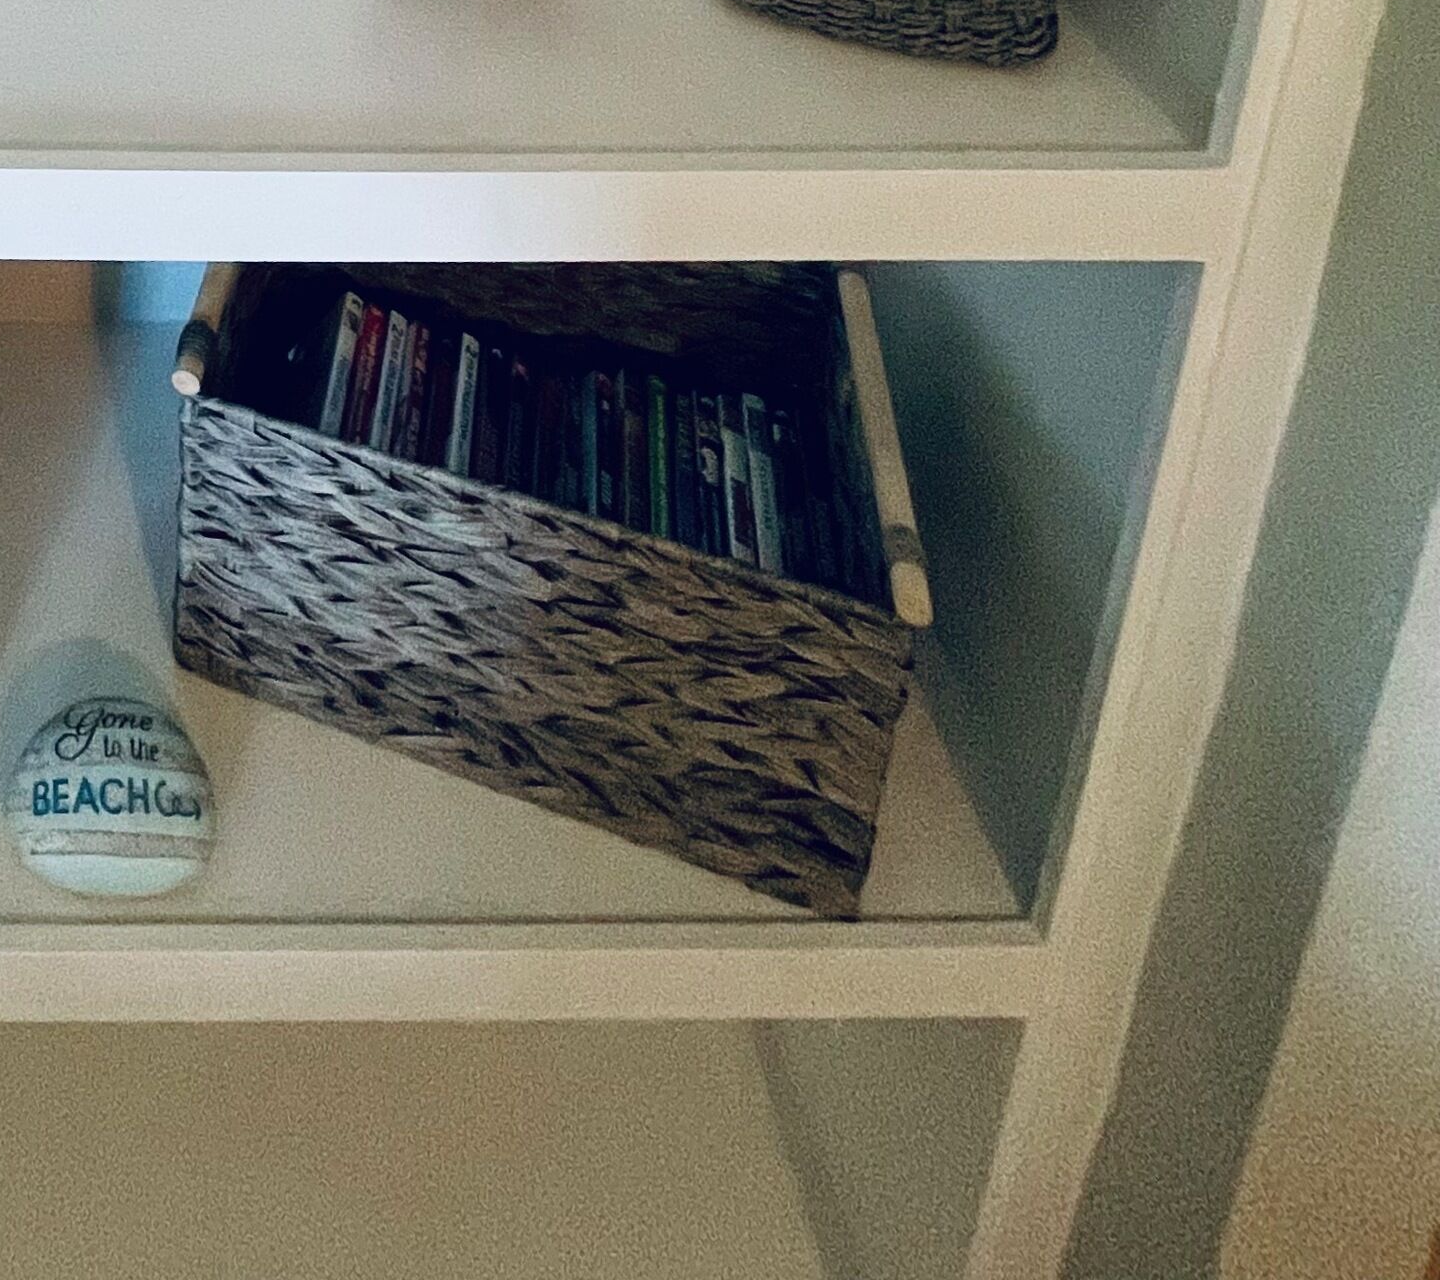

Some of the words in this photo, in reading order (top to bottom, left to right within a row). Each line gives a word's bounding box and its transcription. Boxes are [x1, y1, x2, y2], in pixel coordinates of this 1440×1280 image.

[55, 705, 155, 762] Gone
[130, 736, 160, 763] the
[32, 776, 151, 818] BEACH
